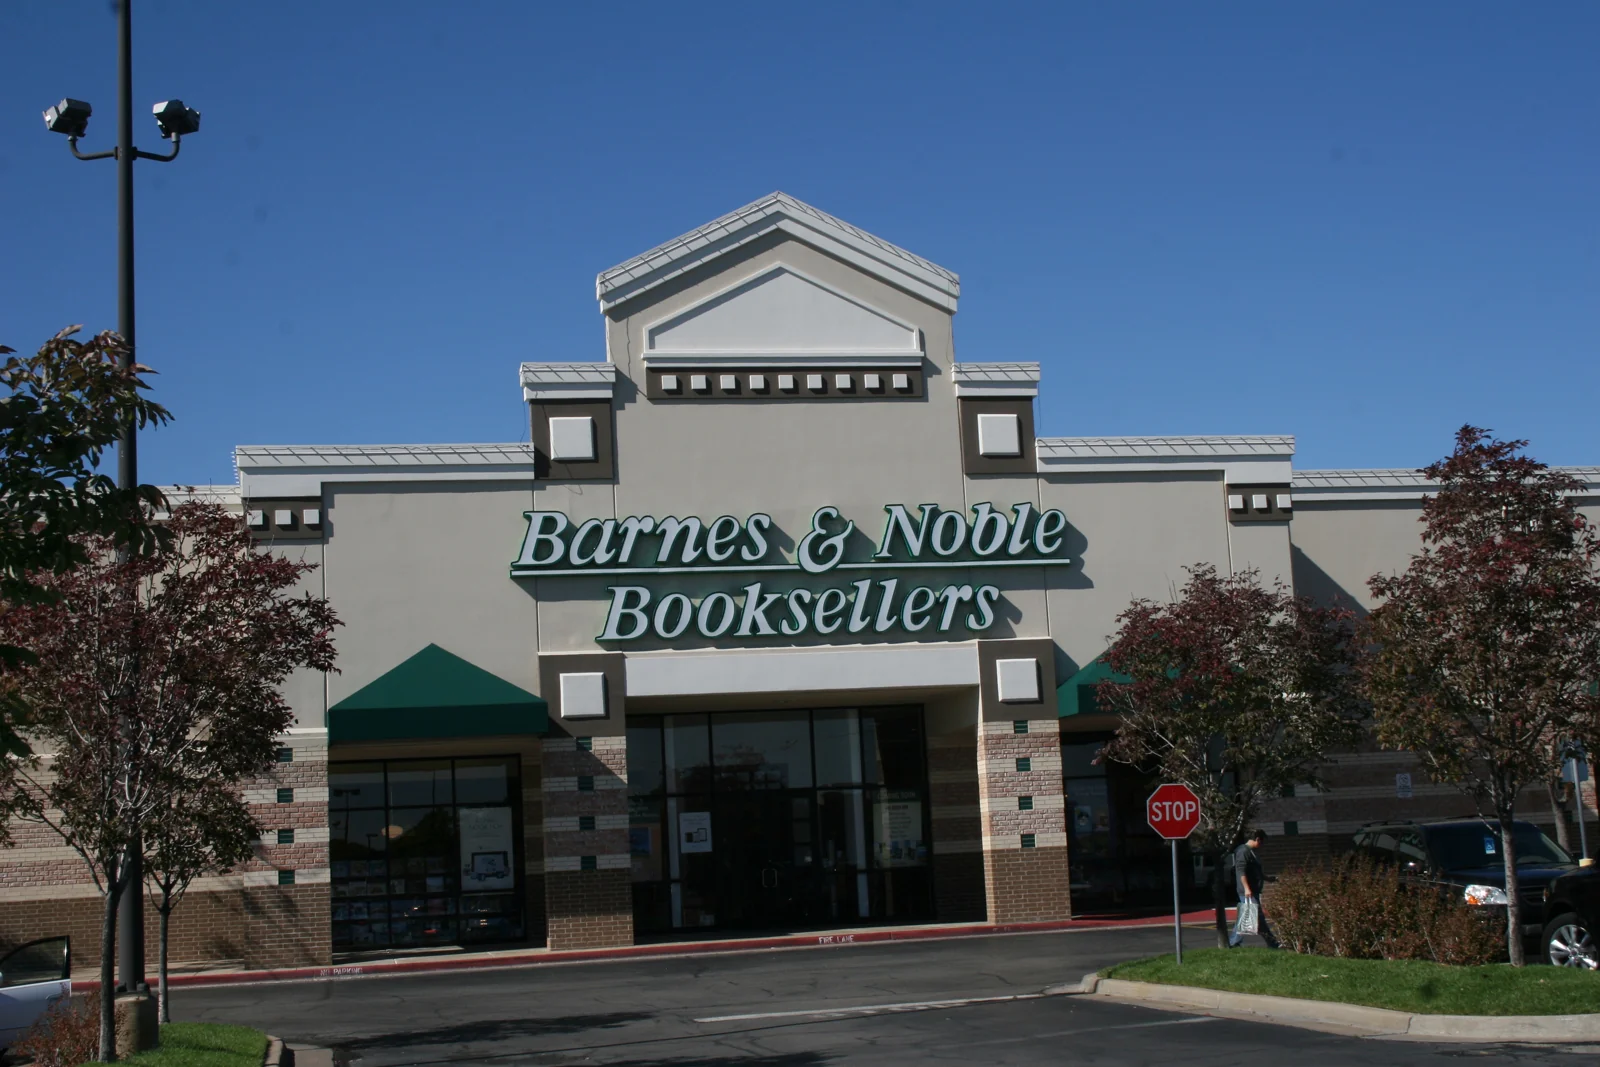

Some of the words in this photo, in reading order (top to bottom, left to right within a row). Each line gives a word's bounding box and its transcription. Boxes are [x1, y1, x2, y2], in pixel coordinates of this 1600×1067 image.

[510, 511, 772, 568] Barnes
[797, 505, 853, 574] &
[872, 502, 1067, 559] Noble
[595, 577, 1000, 642] Booksellers
[1151, 801, 1197, 822] STOP
[818, 936, 834, 945] FIRE
